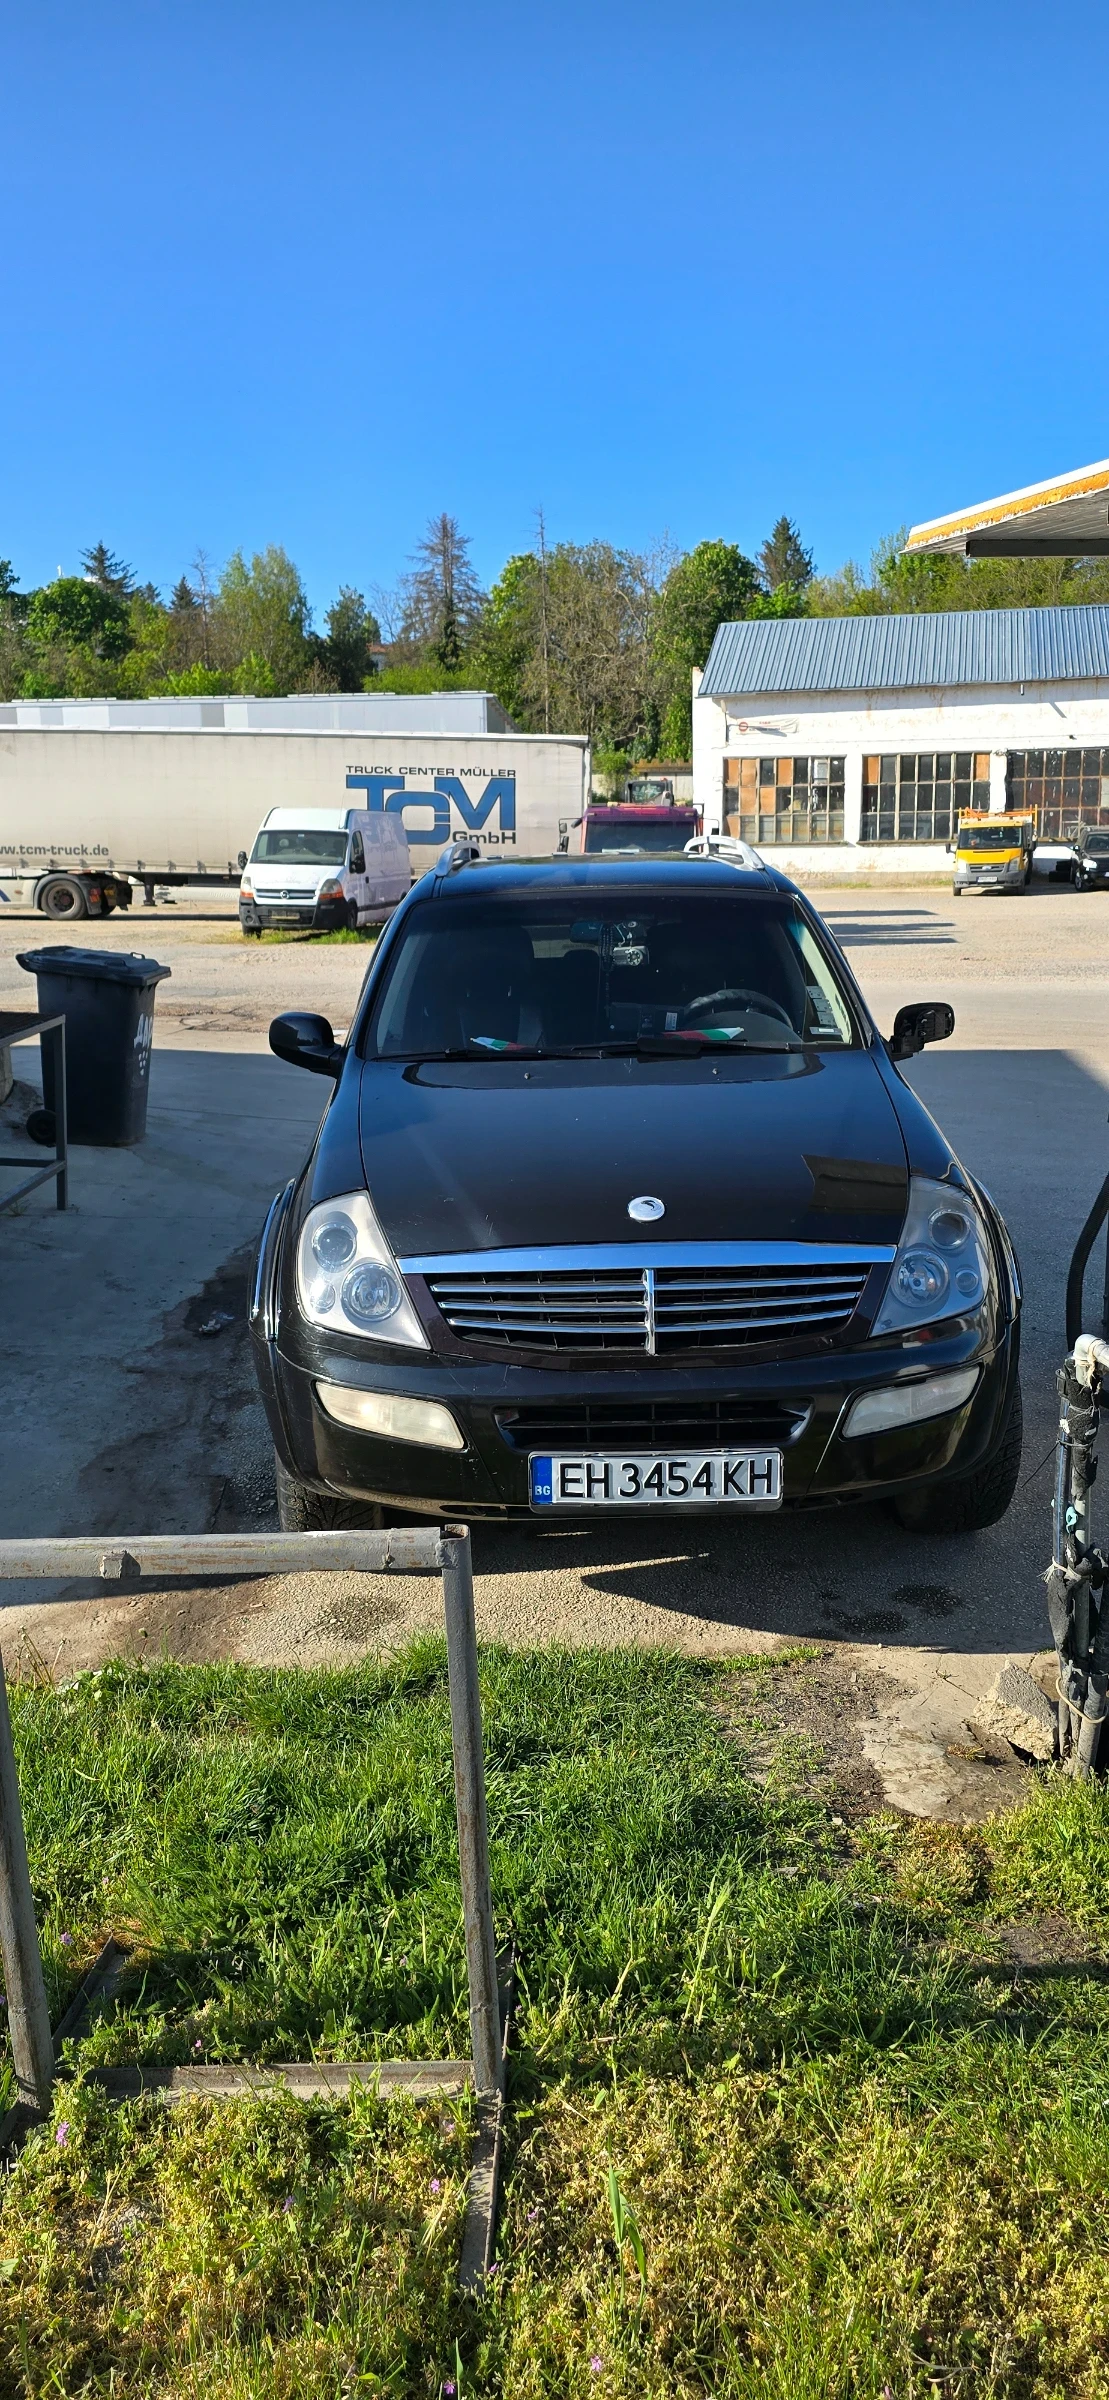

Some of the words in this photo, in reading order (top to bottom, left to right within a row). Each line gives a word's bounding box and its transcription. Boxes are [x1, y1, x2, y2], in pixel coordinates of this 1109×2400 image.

[346, 765, 393, 775] TRUCK
[398, 766, 455, 776] CENTER
[460, 766, 516, 778] MÜLLER
[452, 830, 516, 845] GmbH
[534, 1485, 551, 1496] BG
